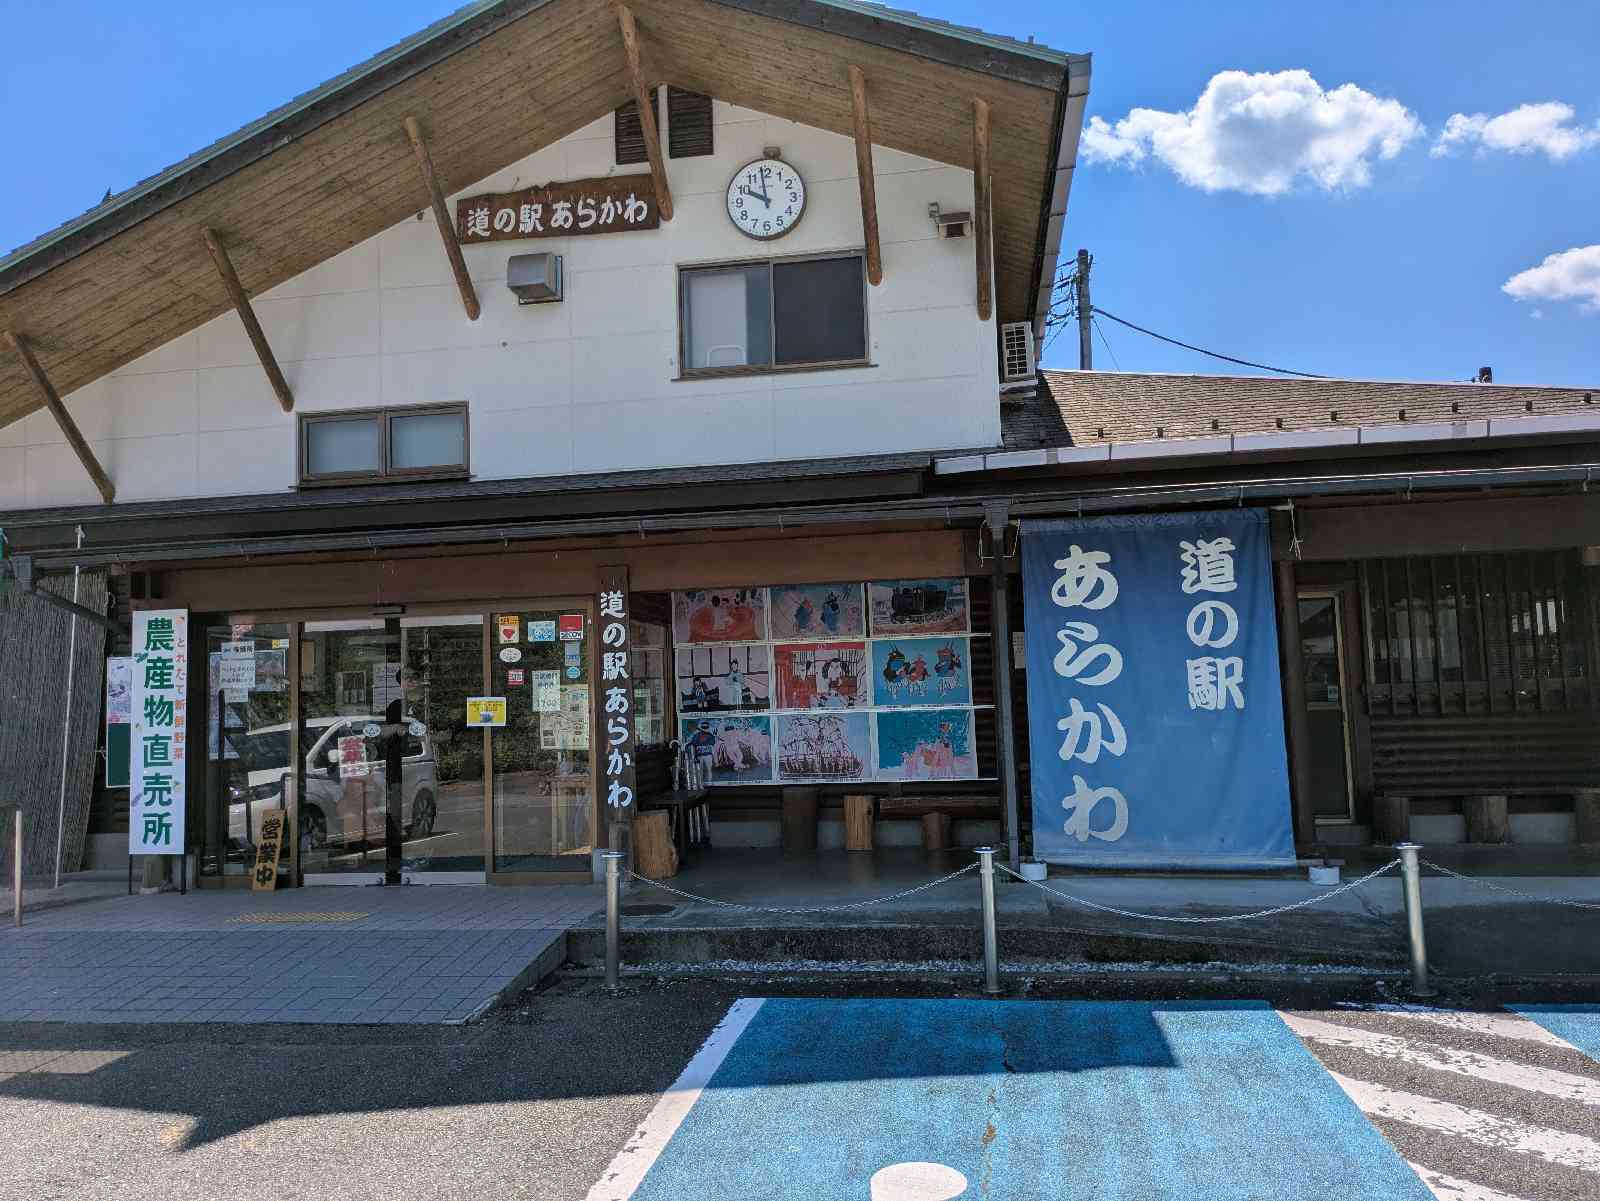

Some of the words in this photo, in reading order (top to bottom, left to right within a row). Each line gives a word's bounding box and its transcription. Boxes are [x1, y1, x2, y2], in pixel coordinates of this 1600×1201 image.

[784, 179, 793, 190] 2
[735, 197, 744, 208] 9
[790, 192, 797, 203] 3
[740, 210, 749, 221] 8
[784, 205, 793, 216] 4
[751, 219, 758, 229] 7
[763, 221, 771, 232] 6
[776, 216, 784, 226] 5
[1179, 537, 1246, 711] 道の駅
[1050, 544, 1129, 842] あらかわ
[600, 590, 634, 809] 道の駅あらかわ
[142, 617, 175, 846] 農産物直売所
